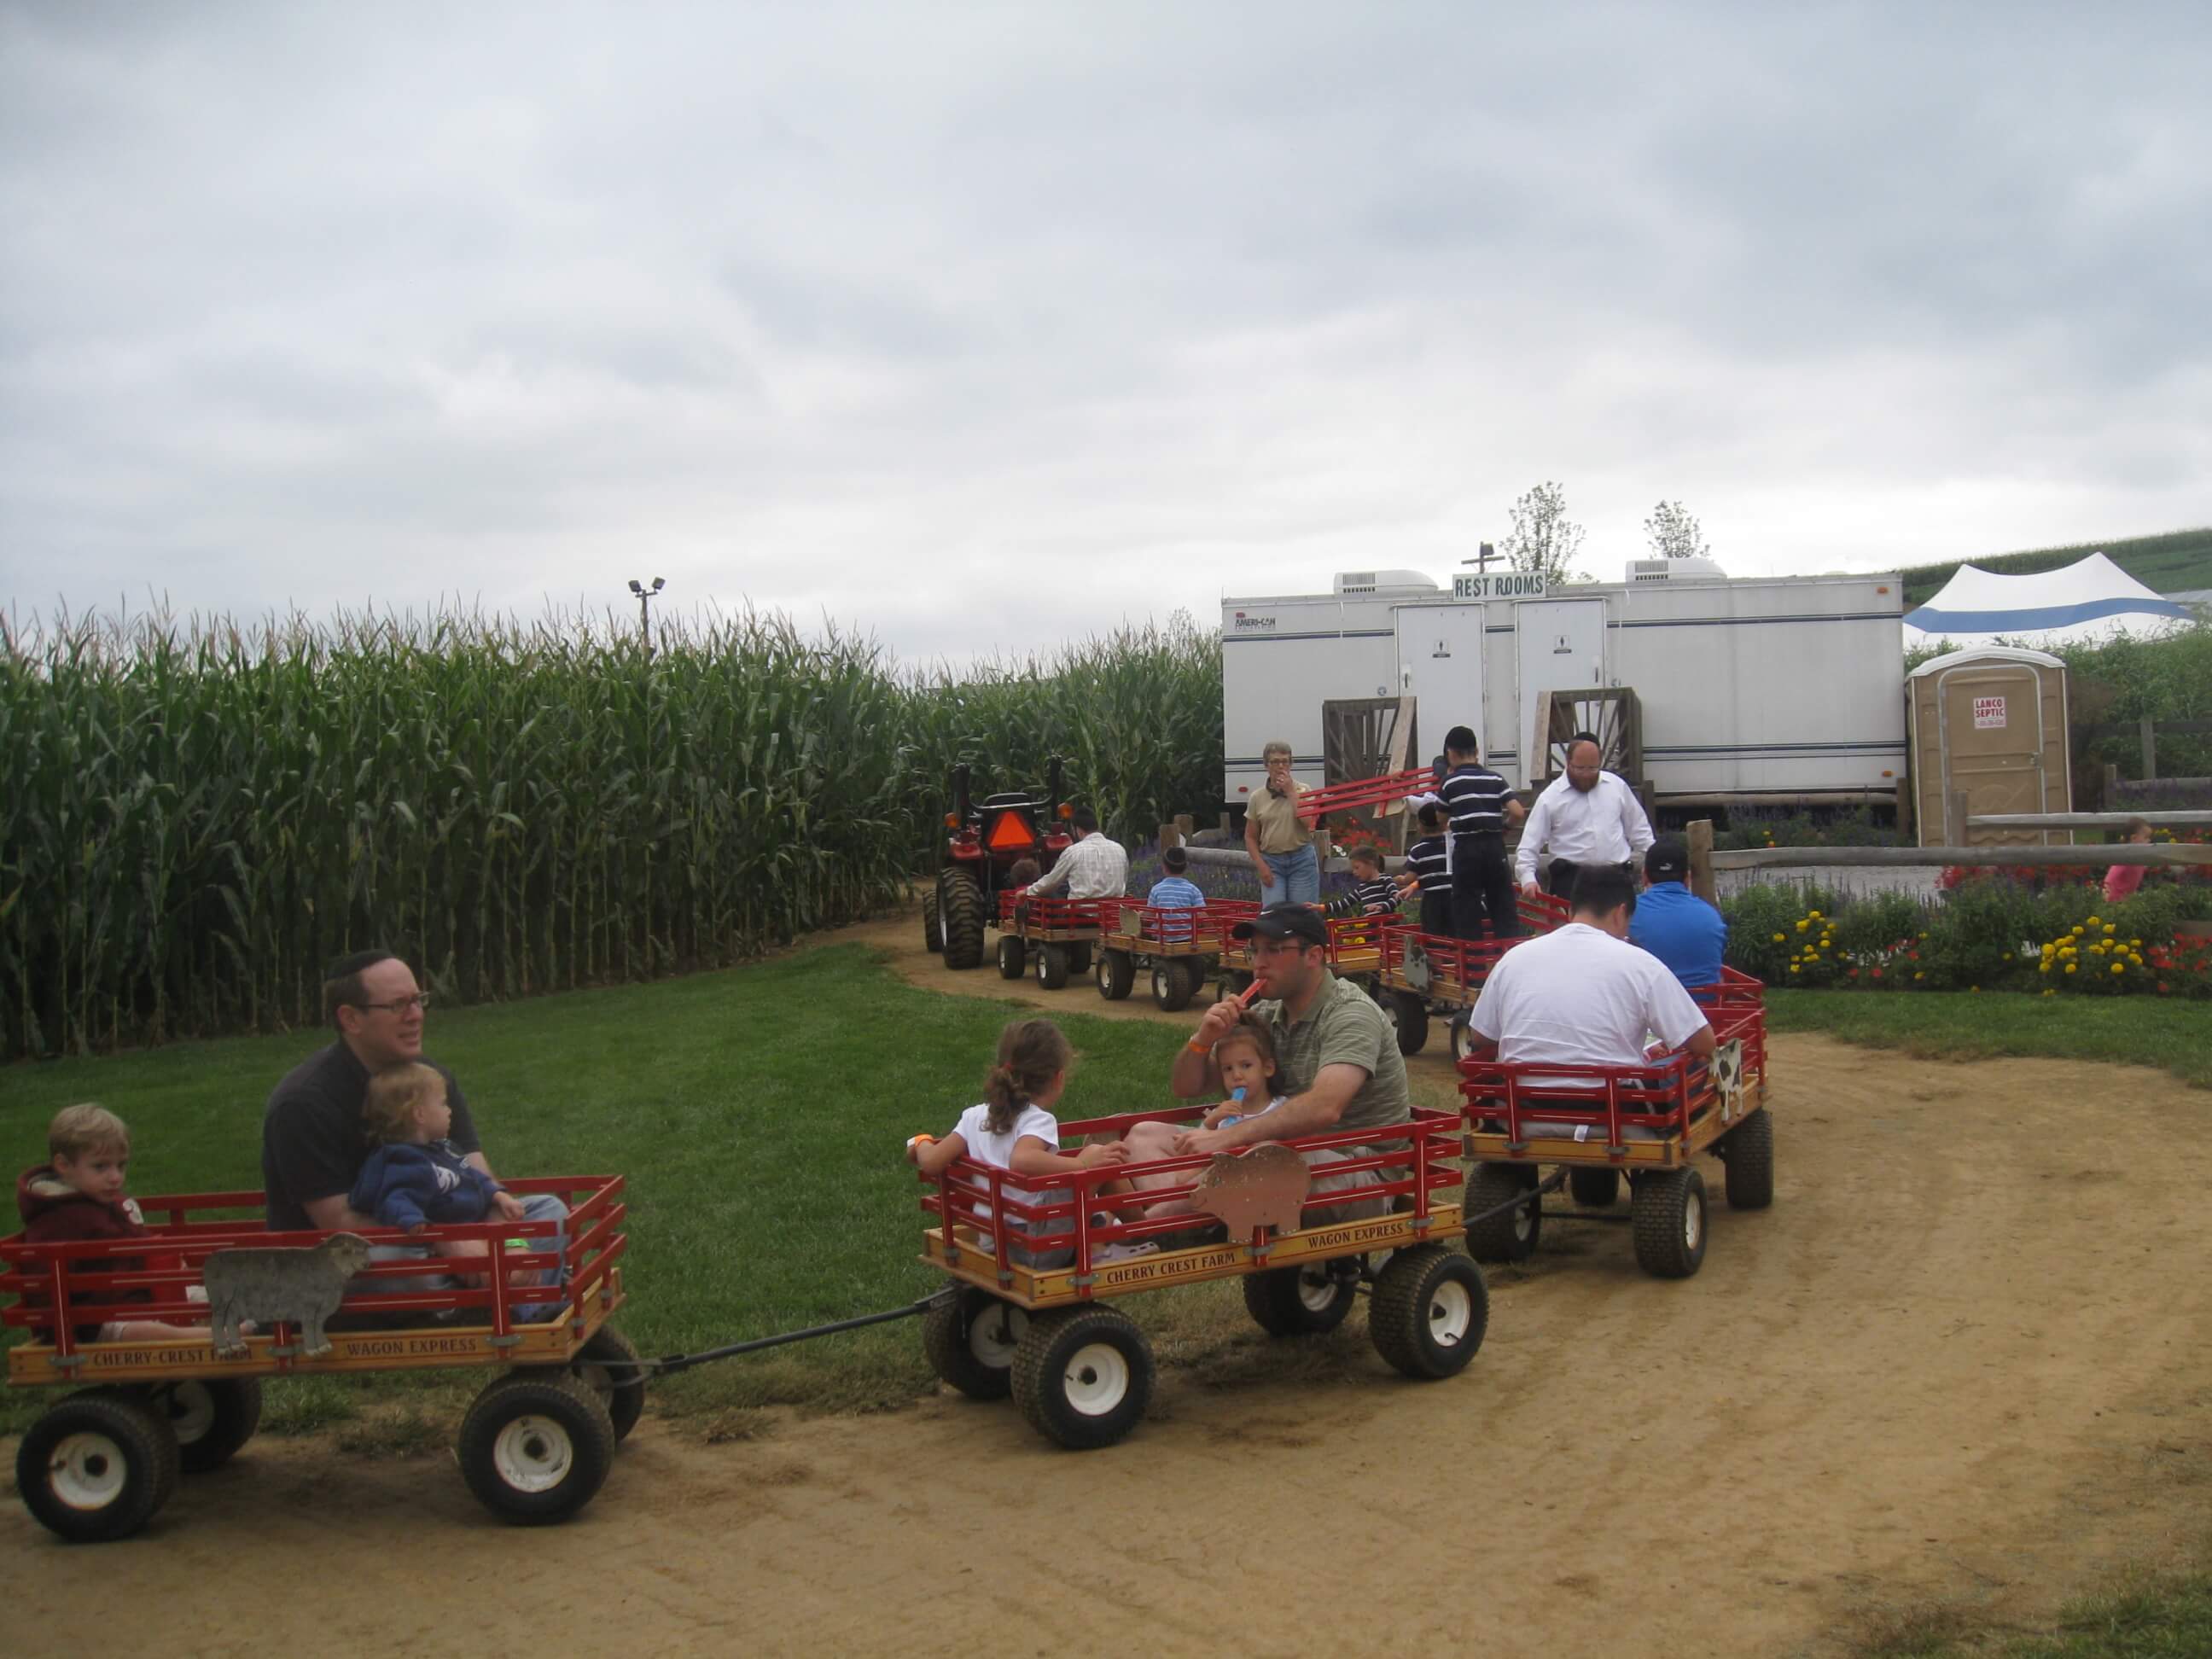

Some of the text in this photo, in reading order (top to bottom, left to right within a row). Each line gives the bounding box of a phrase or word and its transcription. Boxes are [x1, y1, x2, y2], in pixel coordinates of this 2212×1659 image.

[1455, 575, 1544, 597] REST ROOMS
[1976, 699, 2002, 708] LANCO
[1976, 708, 2004, 718] SEPTIC
[1308, 1223, 1404, 1249] WAGON EXPRESS
[1107, 1252, 1236, 1284] CHERRY CREST FARM
[346, 1338, 478, 1356] WAGON EXPRESS
